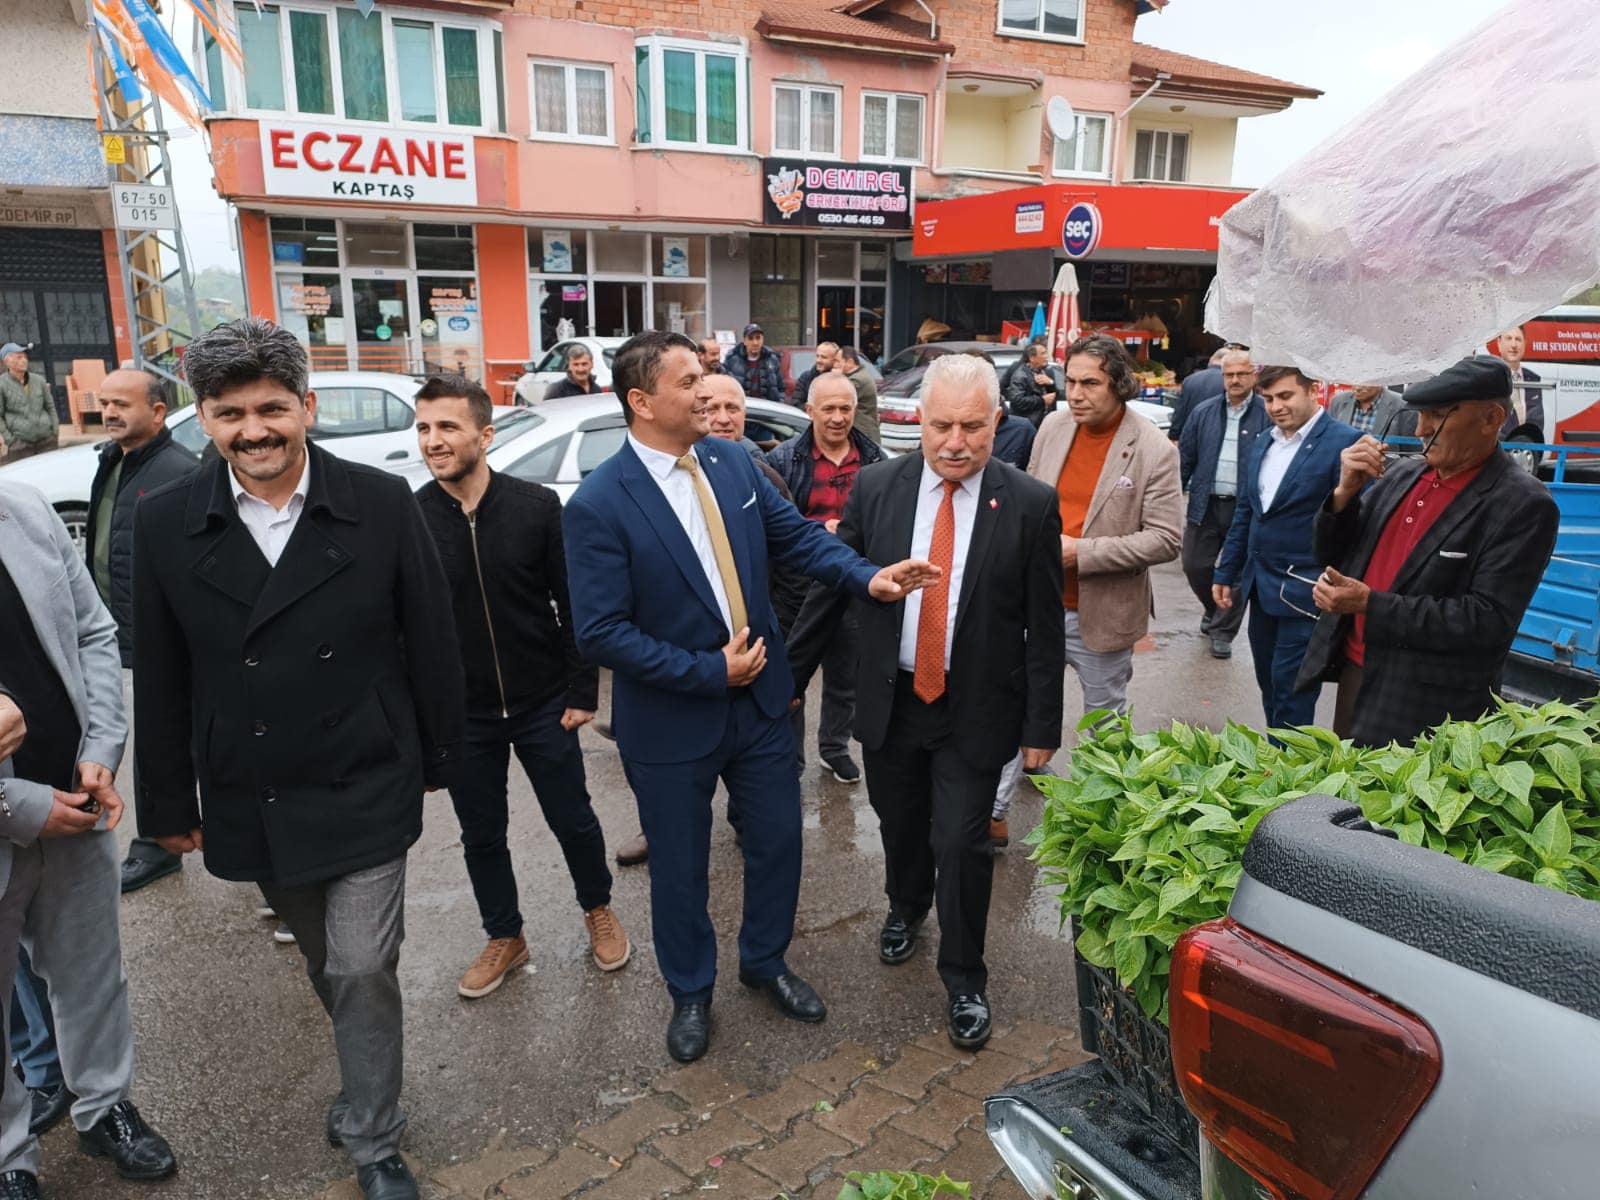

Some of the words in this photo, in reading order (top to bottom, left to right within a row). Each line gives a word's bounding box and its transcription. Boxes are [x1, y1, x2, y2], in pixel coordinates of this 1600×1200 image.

[270, 129, 466, 179] ECZANE
[333, 181, 415, 200] KAPTAŞ
[806, 193, 849, 209] ERKEK
[131, 209, 157, 221] 015
[1065, 220, 1091, 239] seç
[1532, 341, 1548, 351] HER
[1550, 342, 1577, 353] ŞEYDEN
[1578, 341, 1598, 352] ÖNCE
